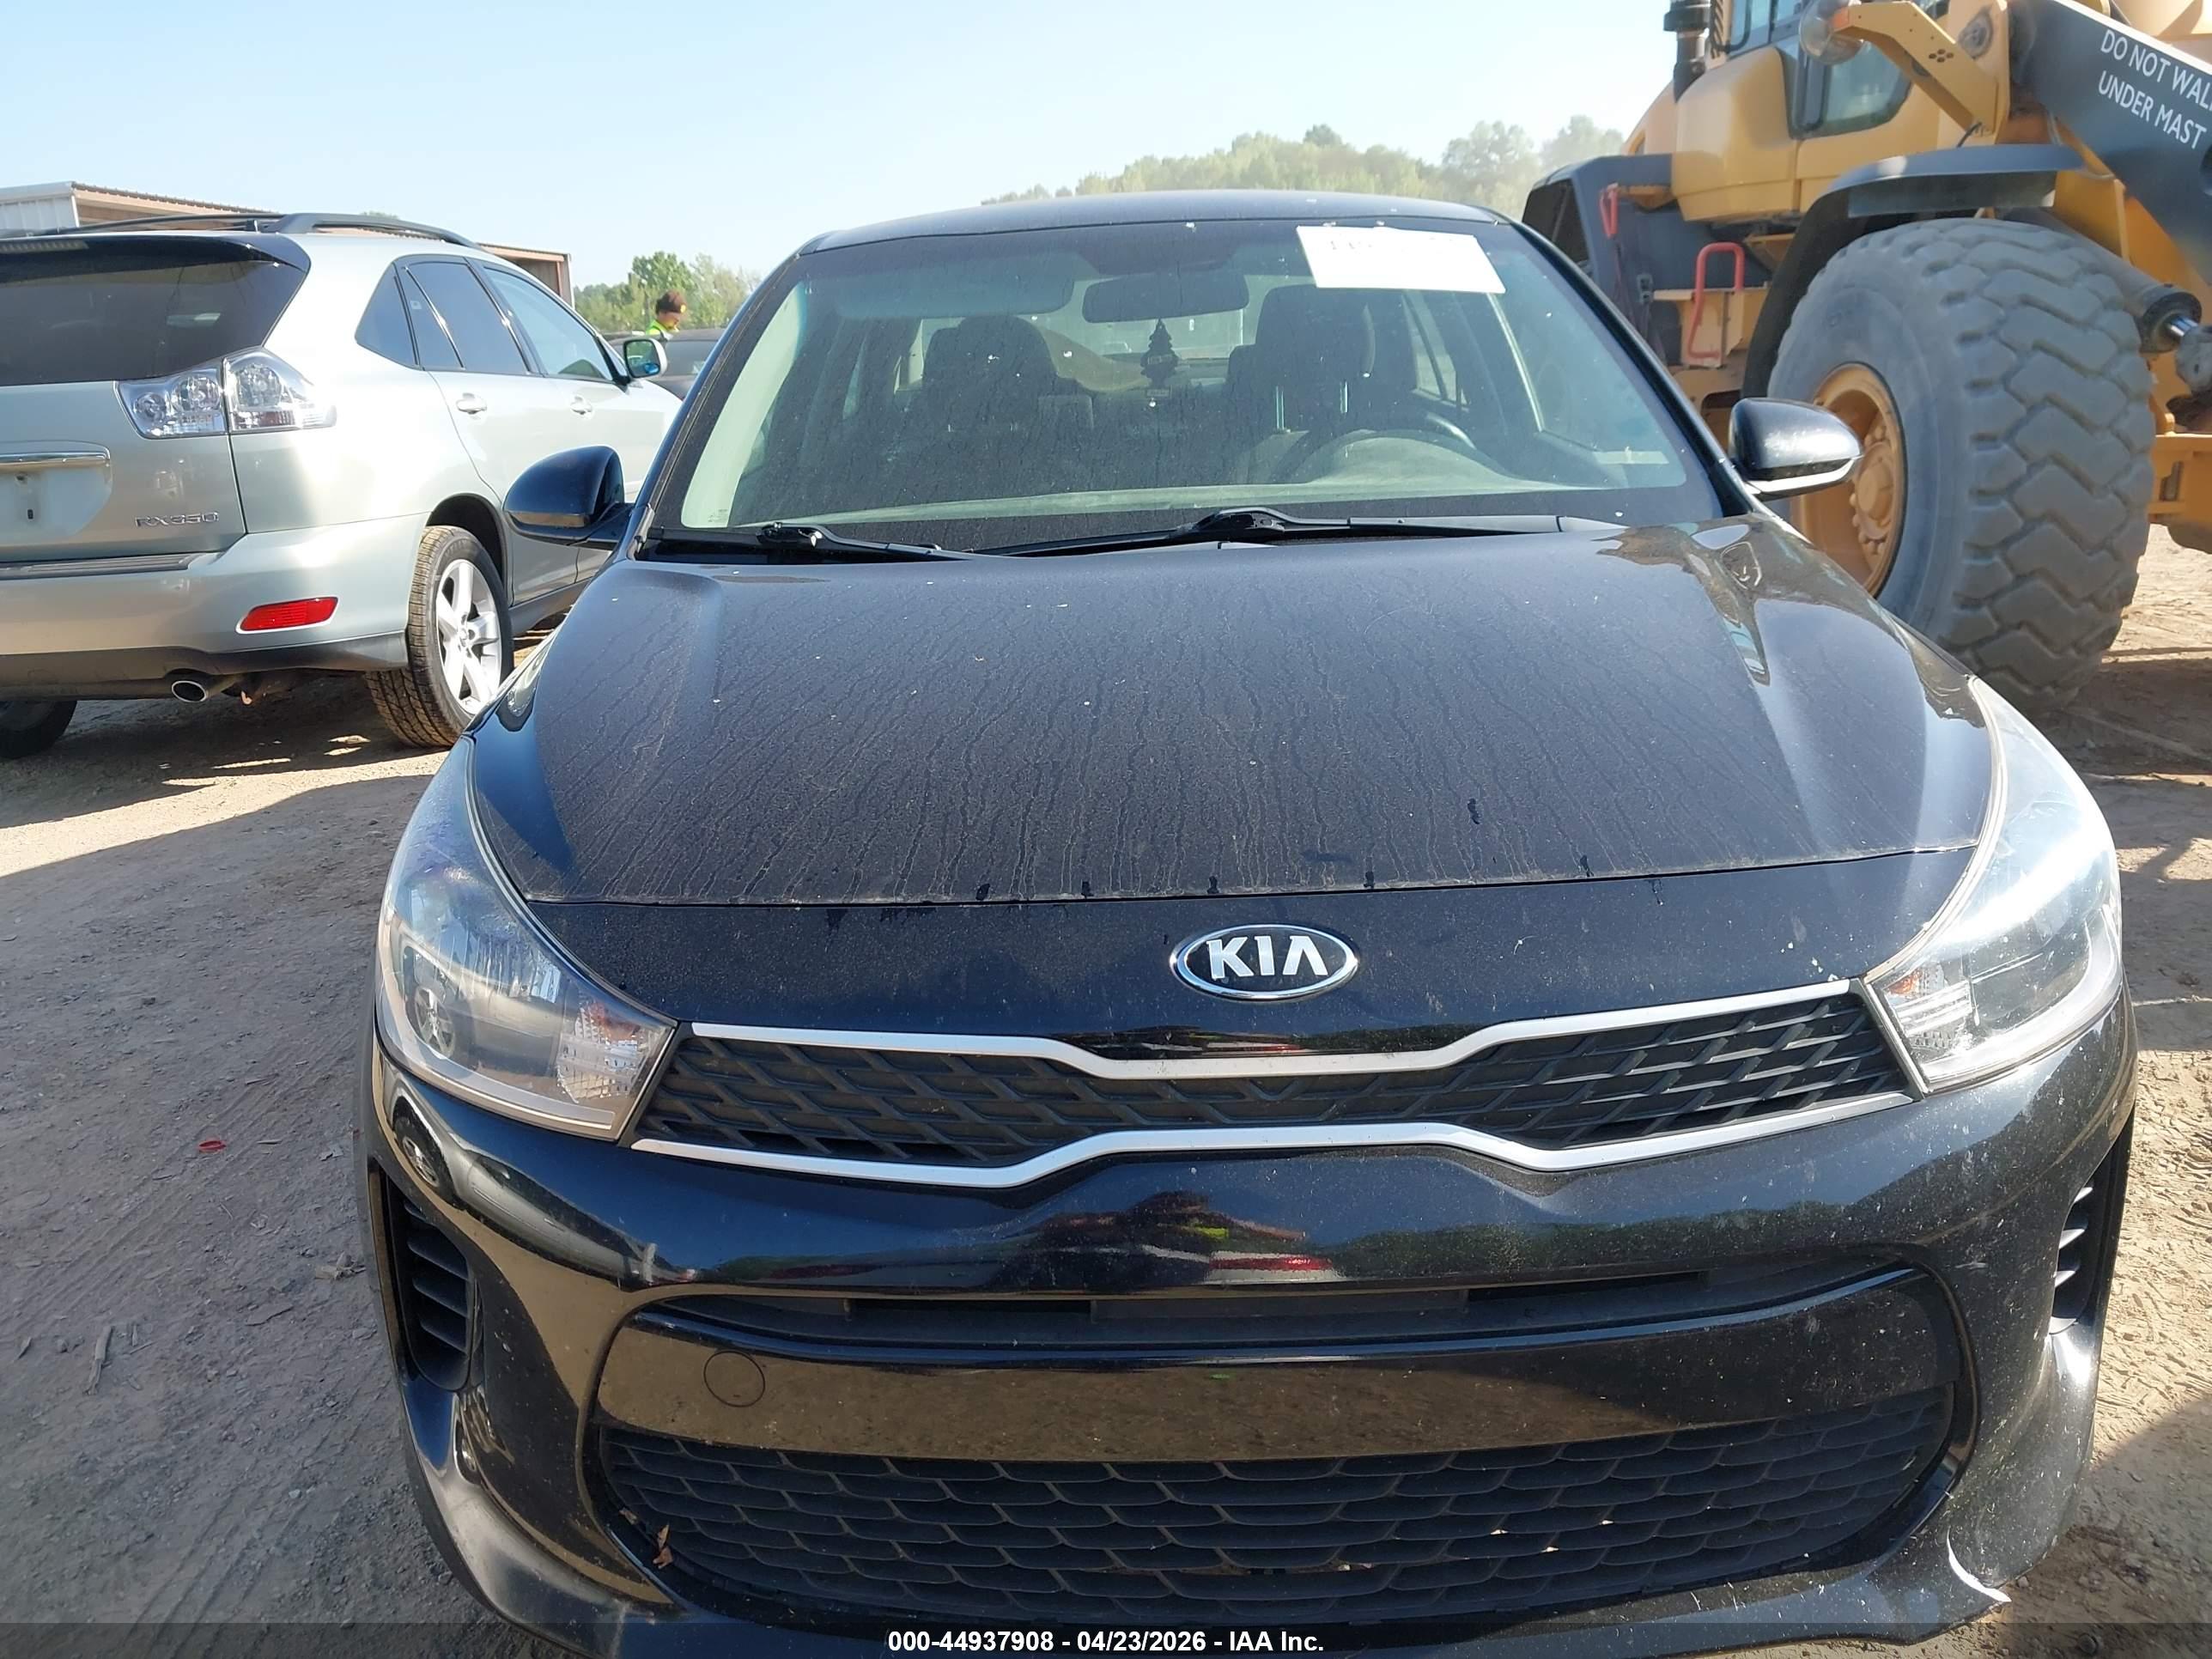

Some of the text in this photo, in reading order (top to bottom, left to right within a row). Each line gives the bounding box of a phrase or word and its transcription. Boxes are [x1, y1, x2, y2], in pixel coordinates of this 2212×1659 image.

[2100, 29, 2212, 112] DO NOT WAL
[2098, 70, 2208, 149] UNDER MAST
[135, 512, 219, 527] RX350
[1206, 935, 1328, 980] KIA
